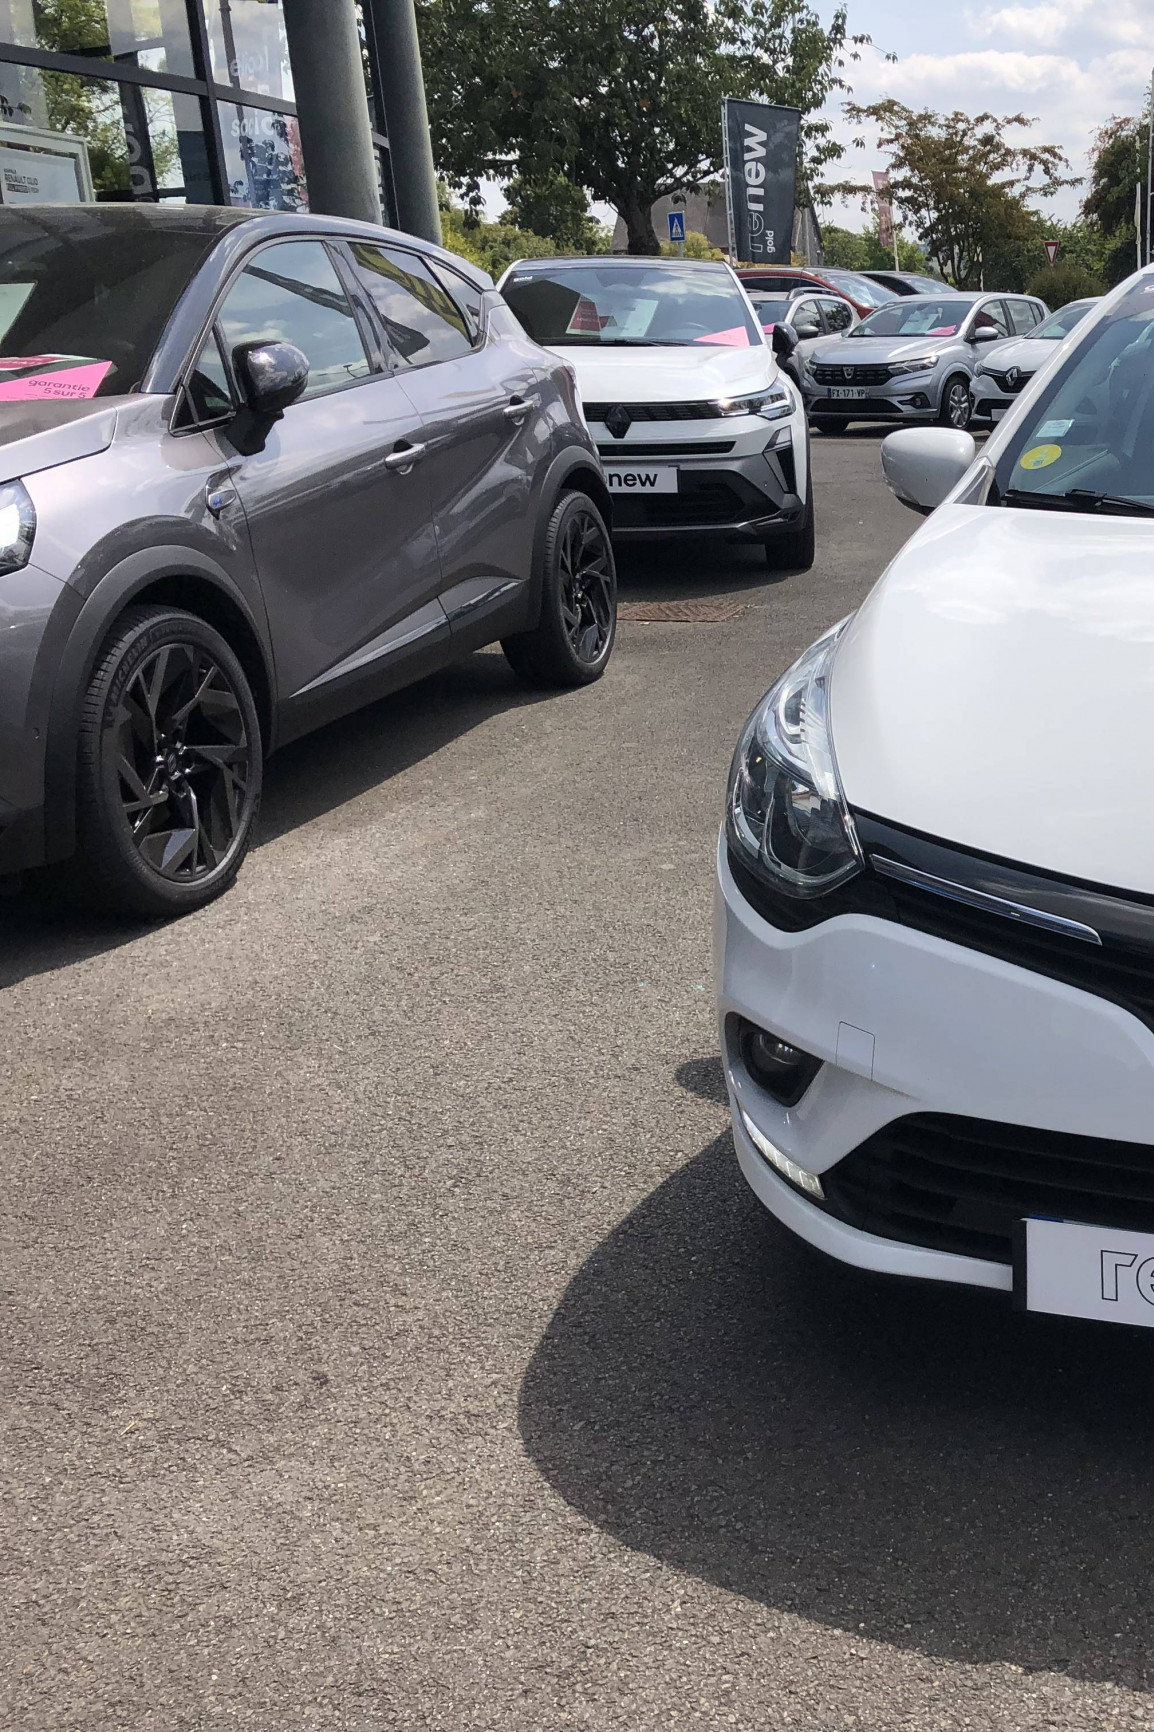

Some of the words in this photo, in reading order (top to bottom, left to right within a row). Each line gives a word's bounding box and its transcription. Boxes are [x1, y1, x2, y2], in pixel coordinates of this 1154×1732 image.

[743, 123, 767, 253] renew
[765, 230, 775, 253] gold
[28, 380, 91, 392] garantie
[53, 389, 77, 397] sur
